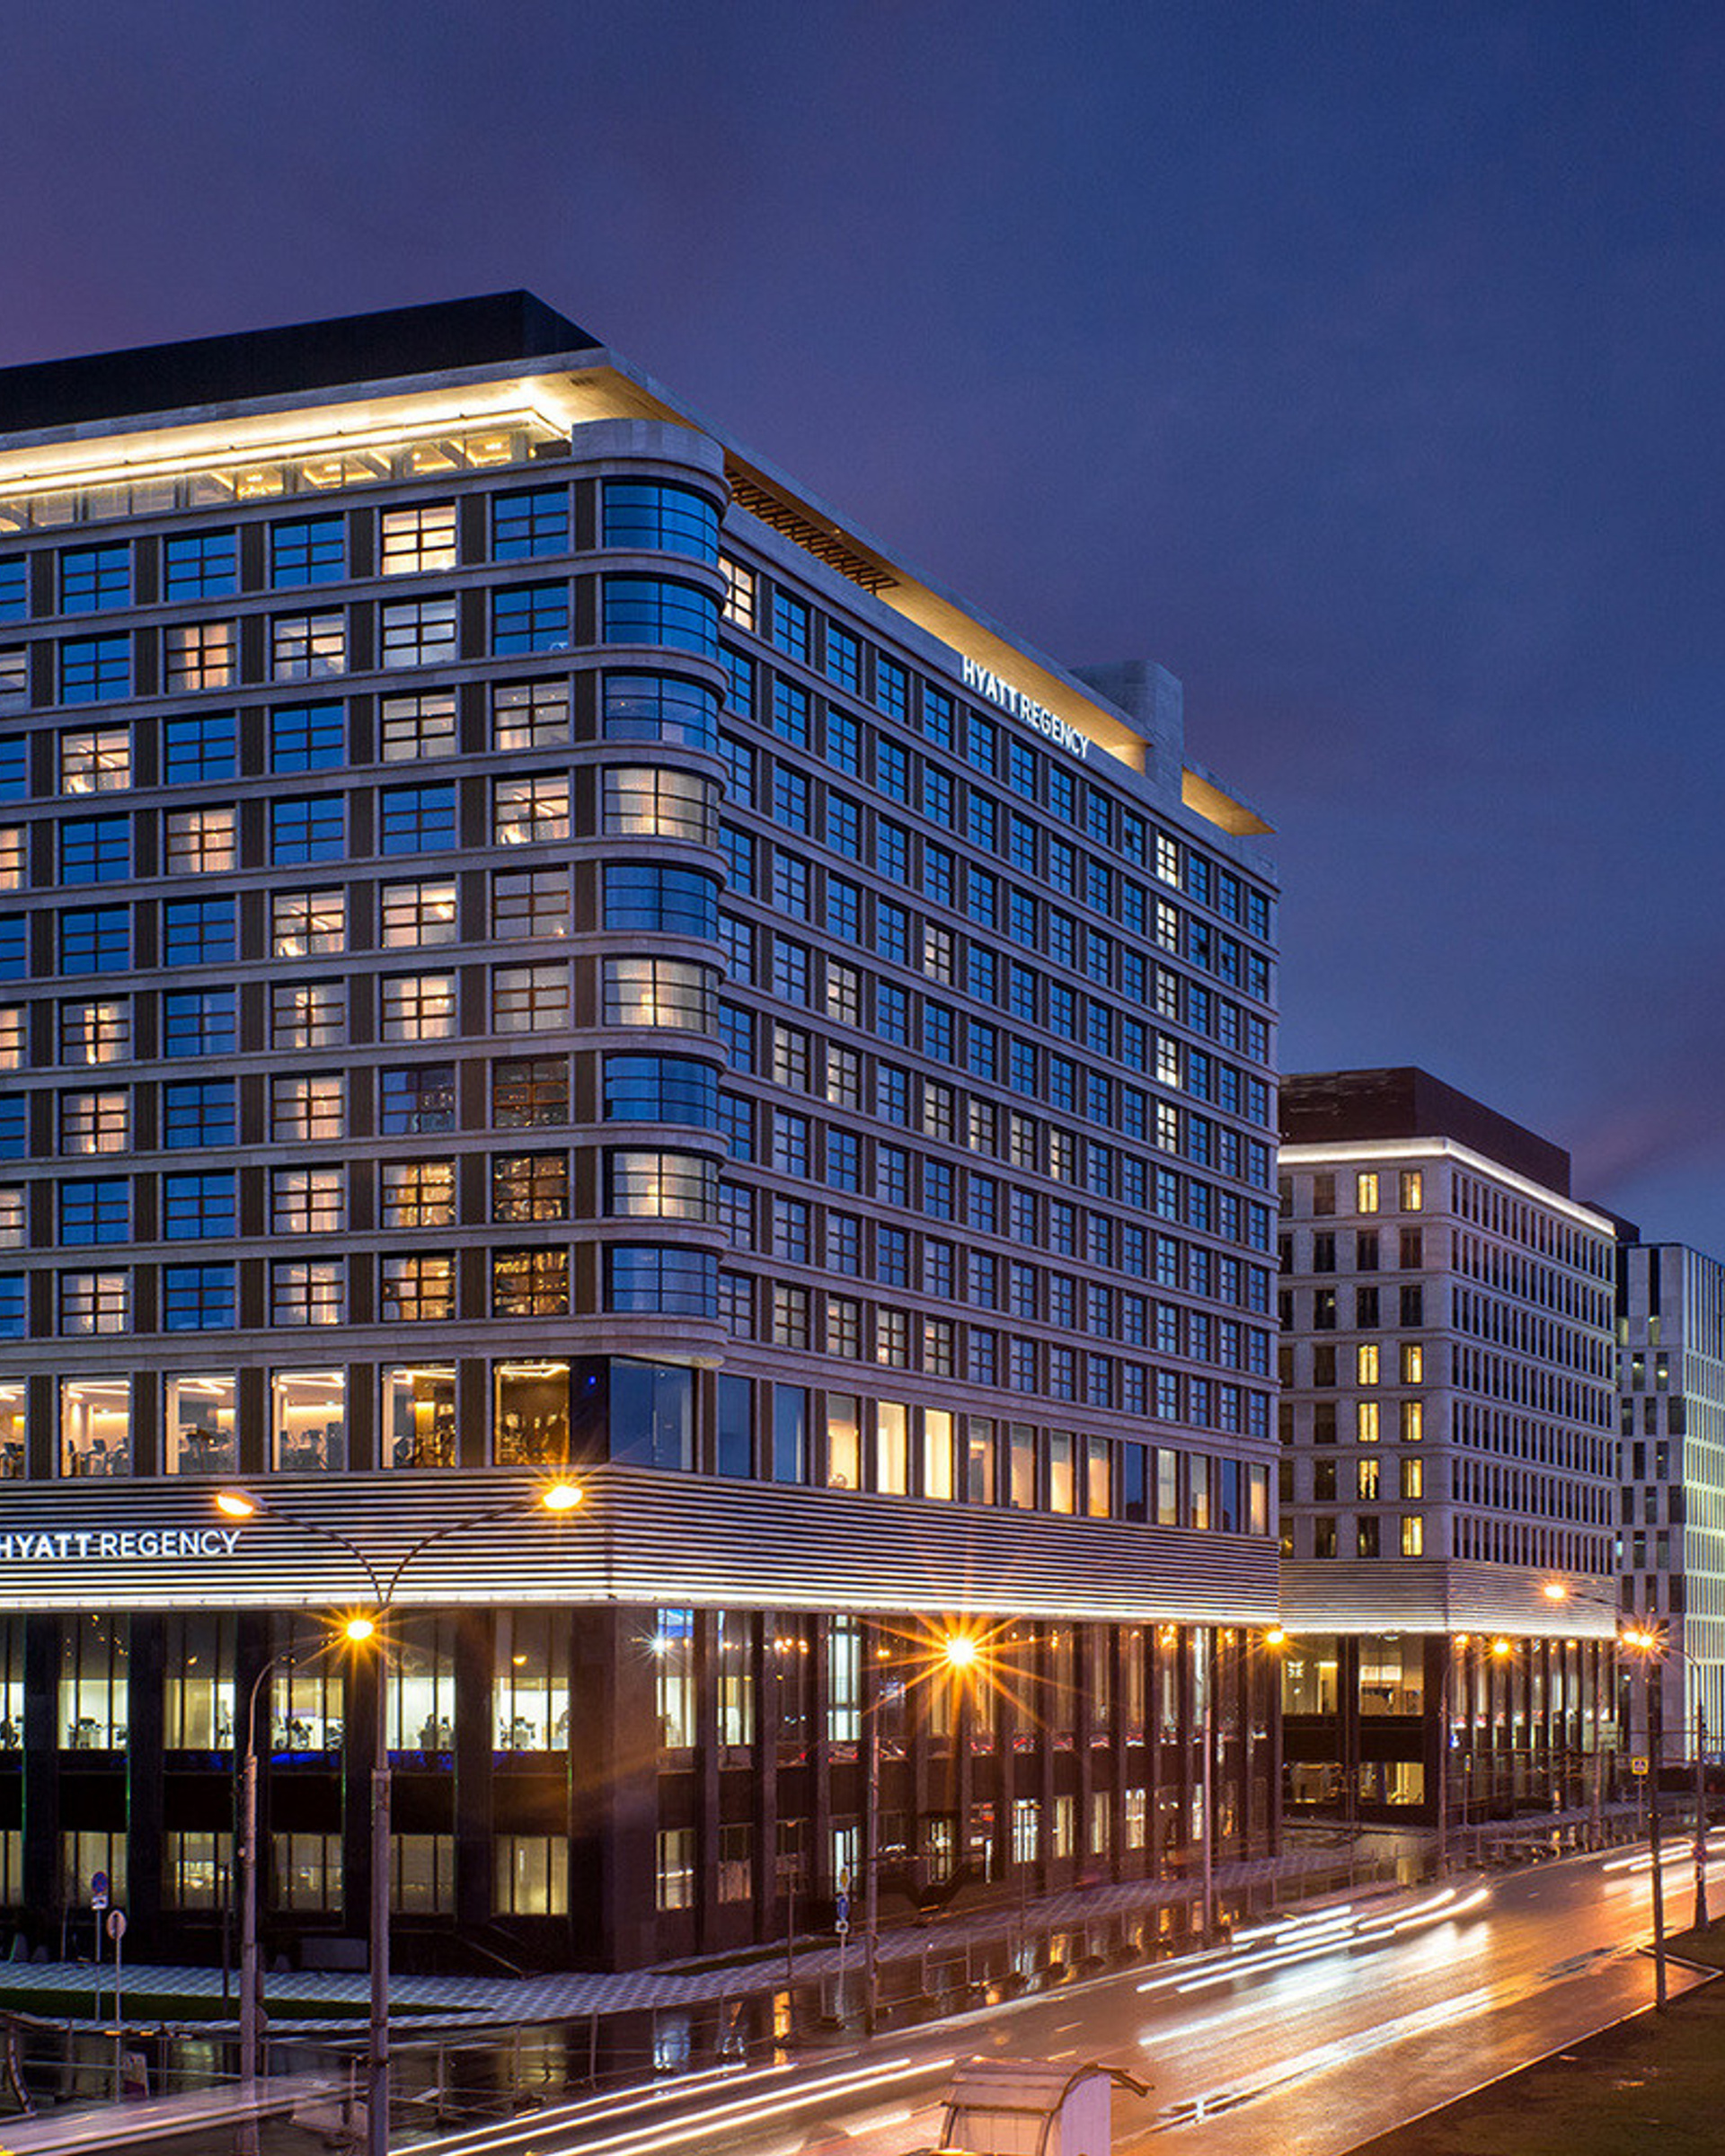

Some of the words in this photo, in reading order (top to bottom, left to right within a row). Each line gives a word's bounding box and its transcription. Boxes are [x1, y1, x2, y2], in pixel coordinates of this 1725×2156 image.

[963, 655, 1017, 713] HYATT
[1020, 693, 1090, 759] REGENCY
[101, 1530, 241, 1558] REGENCY
